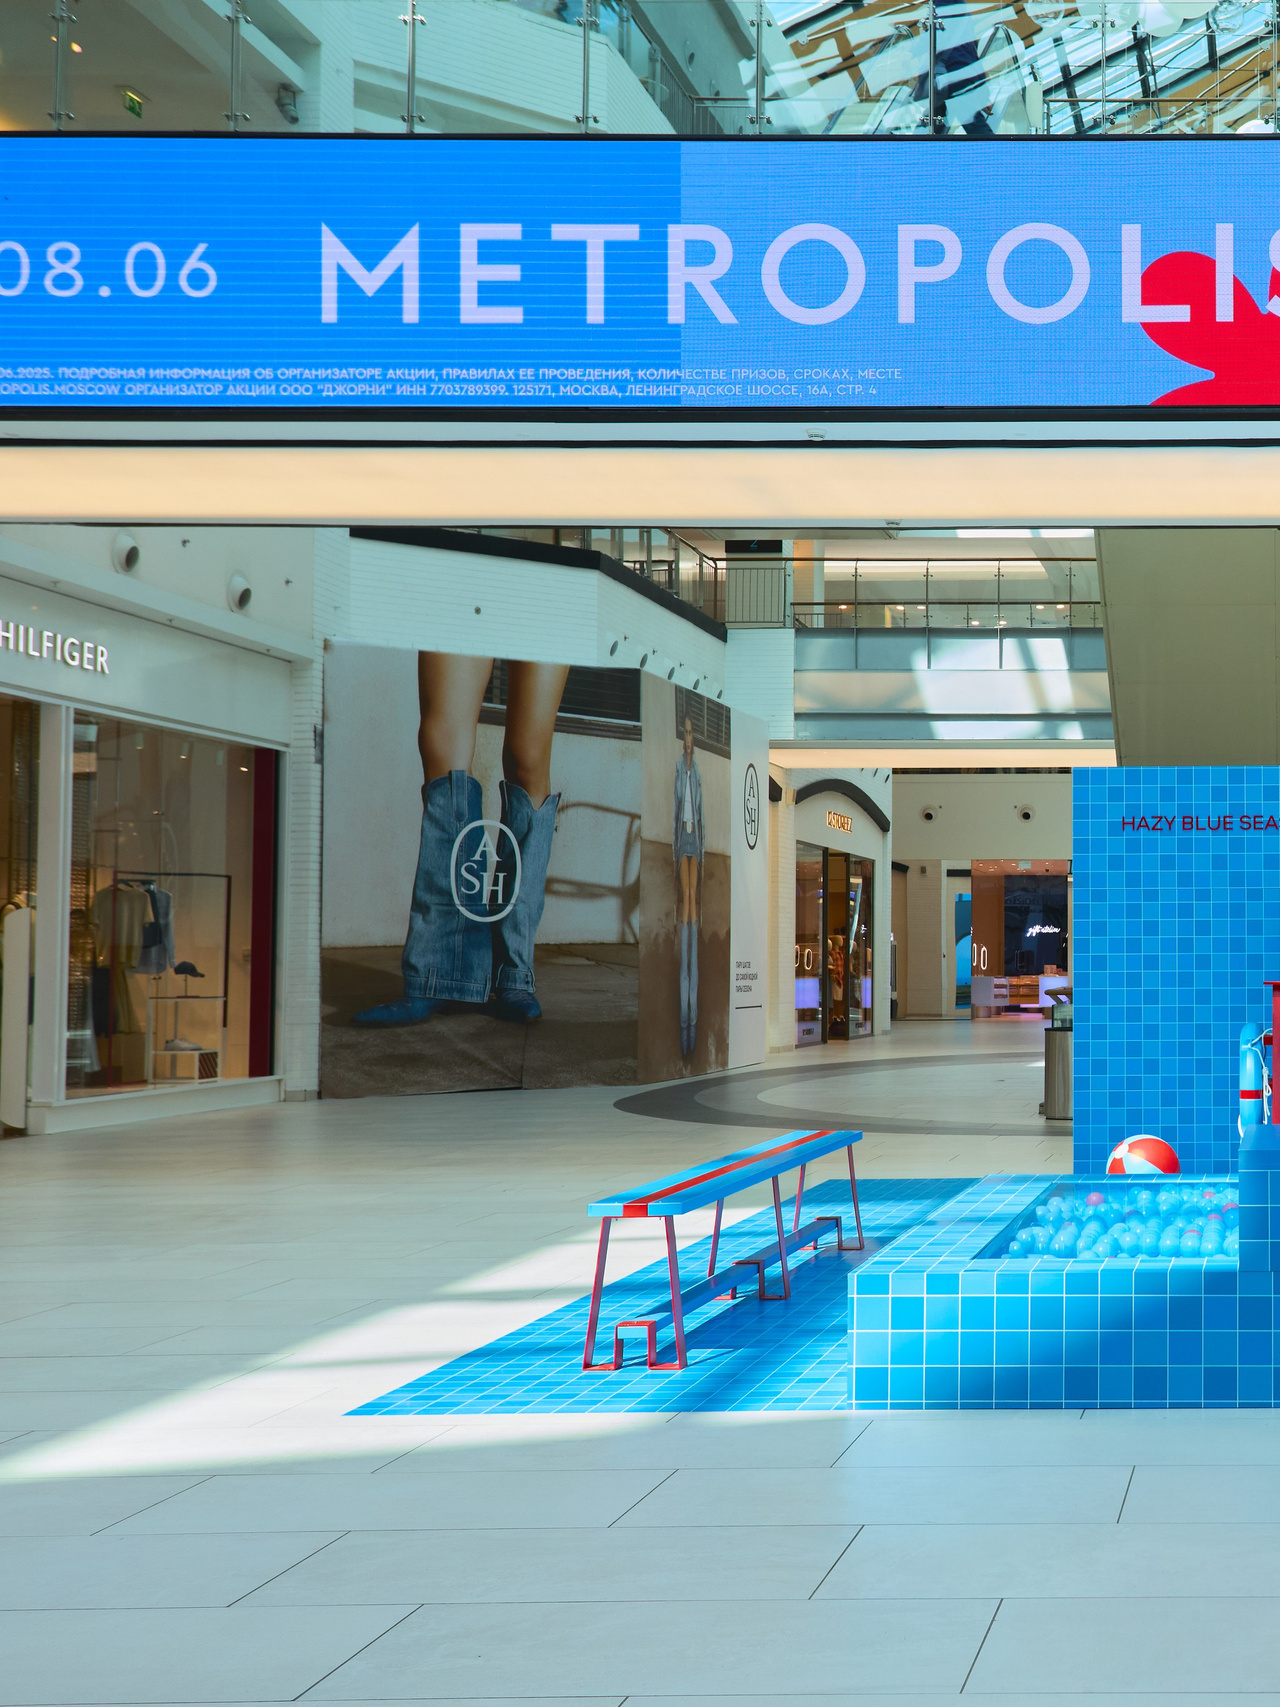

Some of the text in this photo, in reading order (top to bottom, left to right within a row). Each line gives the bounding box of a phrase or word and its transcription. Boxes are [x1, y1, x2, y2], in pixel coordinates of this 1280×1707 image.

[0, 240, 218, 298] 08.06
[58, 367, 146, 380] ПОДРОБНАЯ
[150, 368, 250, 380] ИНФОРМАЦИЯ
[254, 368, 274, 379] ОБ
[277, 368, 382, 380] ОРГАНИЗАТОРЕ
[386, 368, 438, 381] АКЦИИ,
[443, 368, 515, 380] ПРАВИЛАХ
[519, 368, 534, 380] ЕЕ
[539, 368, 634, 381] ПРОВЕДЕНИЯ,
[638, 368, 727, 380] КОЛИЧЕСТВЕ
[731, 368, 790, 381] ПРИЗОВ,
[793, 368, 853, 381] СРОКАХ,
[857, 368, 902, 380] МЕСТЕ
[125, 384, 223, 395] ОРГАНИЗАТОР
[226, 384, 276, 397] АКЦИИ
[279, 384, 313, 395] ООО
[396, 384, 426, 396] ИНН
[430, 385, 509, 396] 7703789399.
[512, 385, 555, 398] 125171,
[559, 385, 622, 398] МОСКВА,
[625, 385, 742, 397] ЛЕНИНГРАДСКОЕ
[747, 385, 802, 397] ШОССЕ,
[836, 385, 864, 395] СТР.
[868, 385, 877, 395] 4
[0, 619, 109, 674] HILFIGER
[1122, 815, 1176, 831] HAZY
[1182, 815, 1234, 831] BLUE
